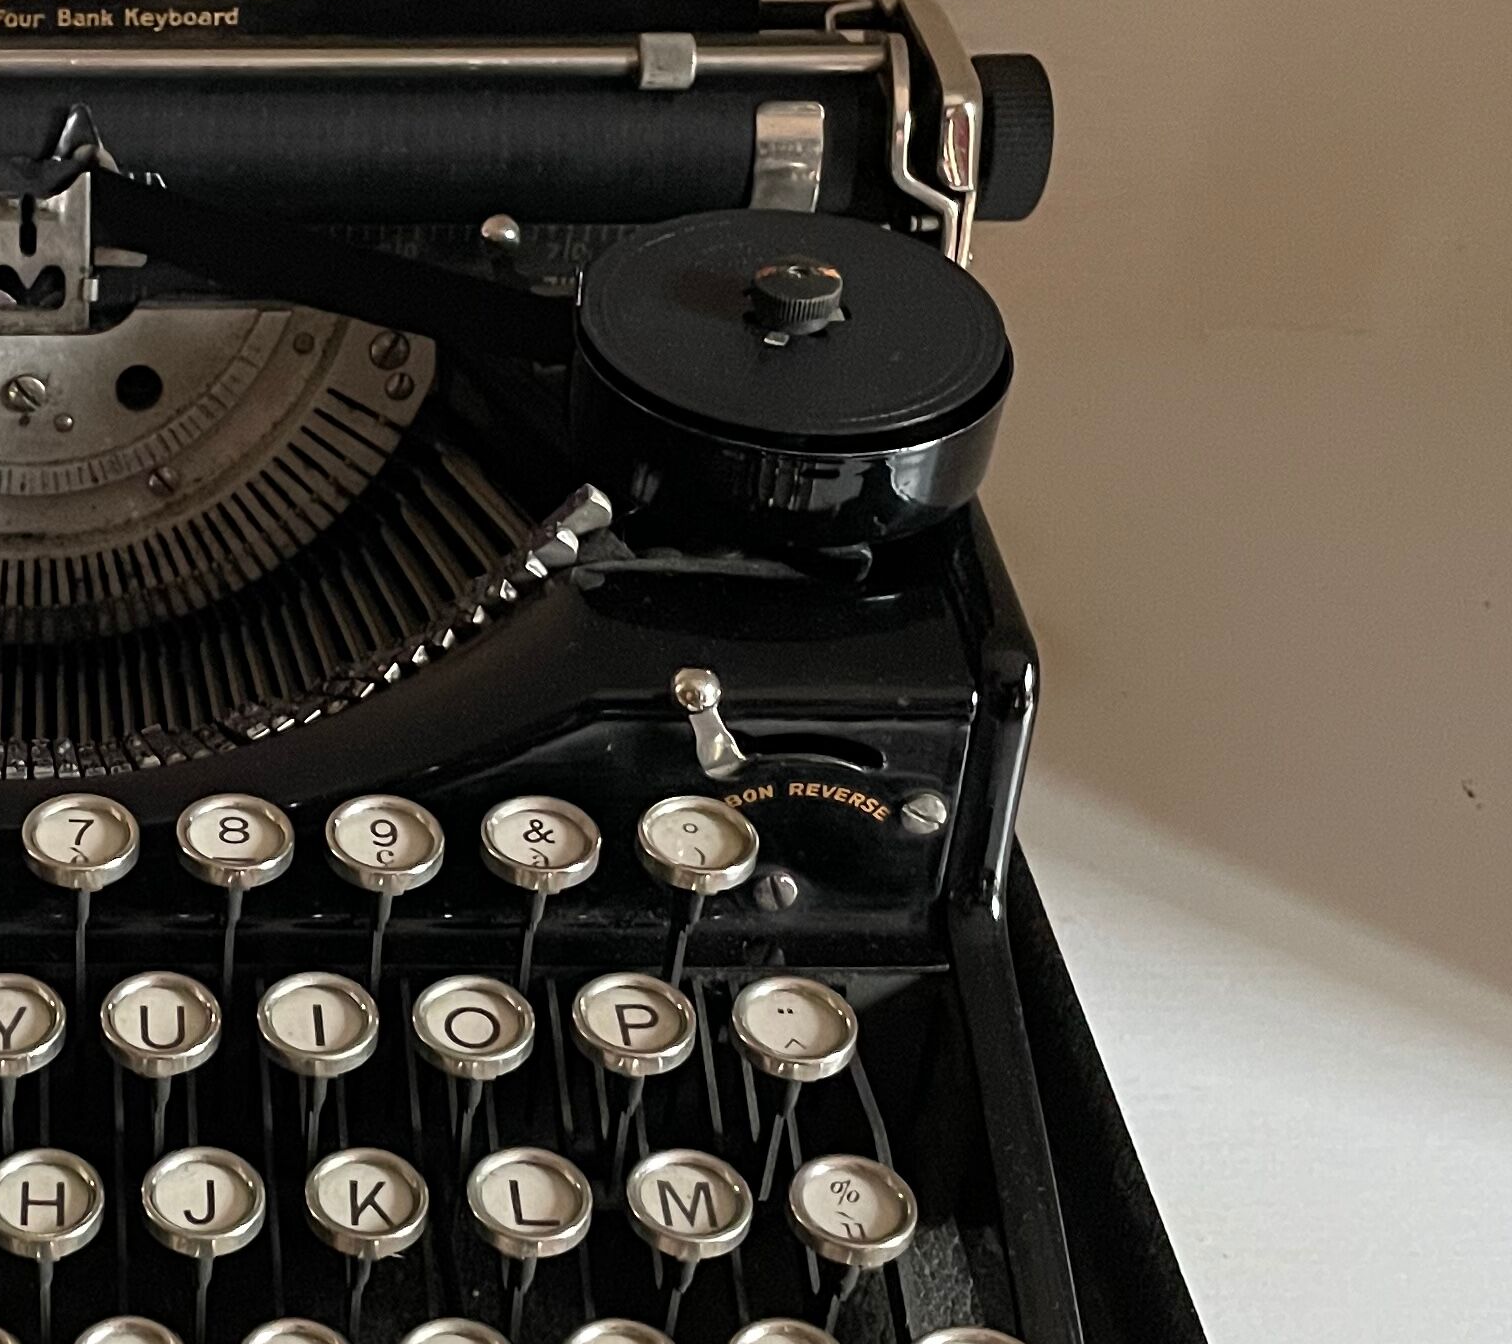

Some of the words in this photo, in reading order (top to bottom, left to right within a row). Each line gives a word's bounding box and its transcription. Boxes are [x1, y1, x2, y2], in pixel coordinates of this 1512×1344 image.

[58, 8, 113, 28] Bank
[124, 7, 239, 32] Keyboard
[789, 782, 890, 822] REVERSE
[68, 818, 94, 845] 7
[218, 816, 250, 844] 8
[370, 819, 398, 847] 9
[522, 819, 556, 844] &
[140, 1006, 185, 1048] U
[312, 1004, 326, 1046] I
[444, 1006, 500, 1048] O
[614, 1003, 658, 1045] P
[20, 1181, 65, 1227] H
[183, 1180, 216, 1225] J
[350, 1180, 390, 1226] K
[510, 1180, 559, 1226] L
[657, 1180, 718, 1227] M
